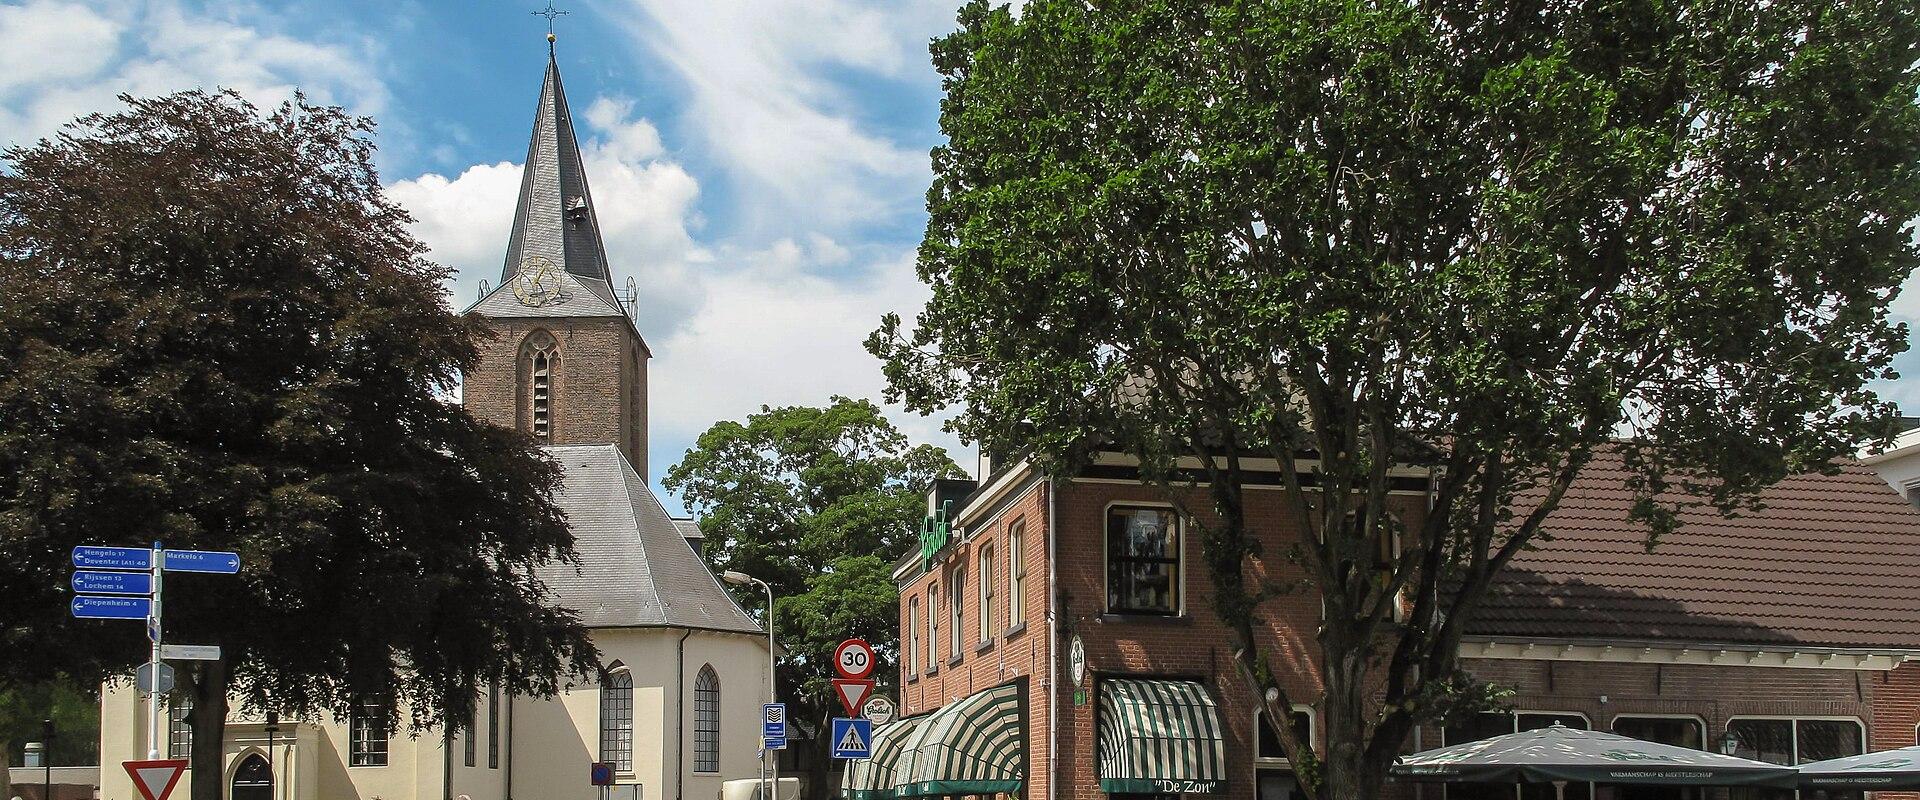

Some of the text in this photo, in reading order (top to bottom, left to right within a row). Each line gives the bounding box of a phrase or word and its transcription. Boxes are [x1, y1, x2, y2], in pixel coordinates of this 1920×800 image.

[84, 549, 116, 557] Hengelo
[166, 552, 197, 560] Markelo
[84, 574, 113, 582] Rijssen
[84, 582, 114, 590] Lochem
[84, 599, 130, 607] Diepenheim
[843, 651, 867, 667] 30
[866, 705, 890, 716] Grolsch
[1155, 779, 1216, 794] "De Zon"
